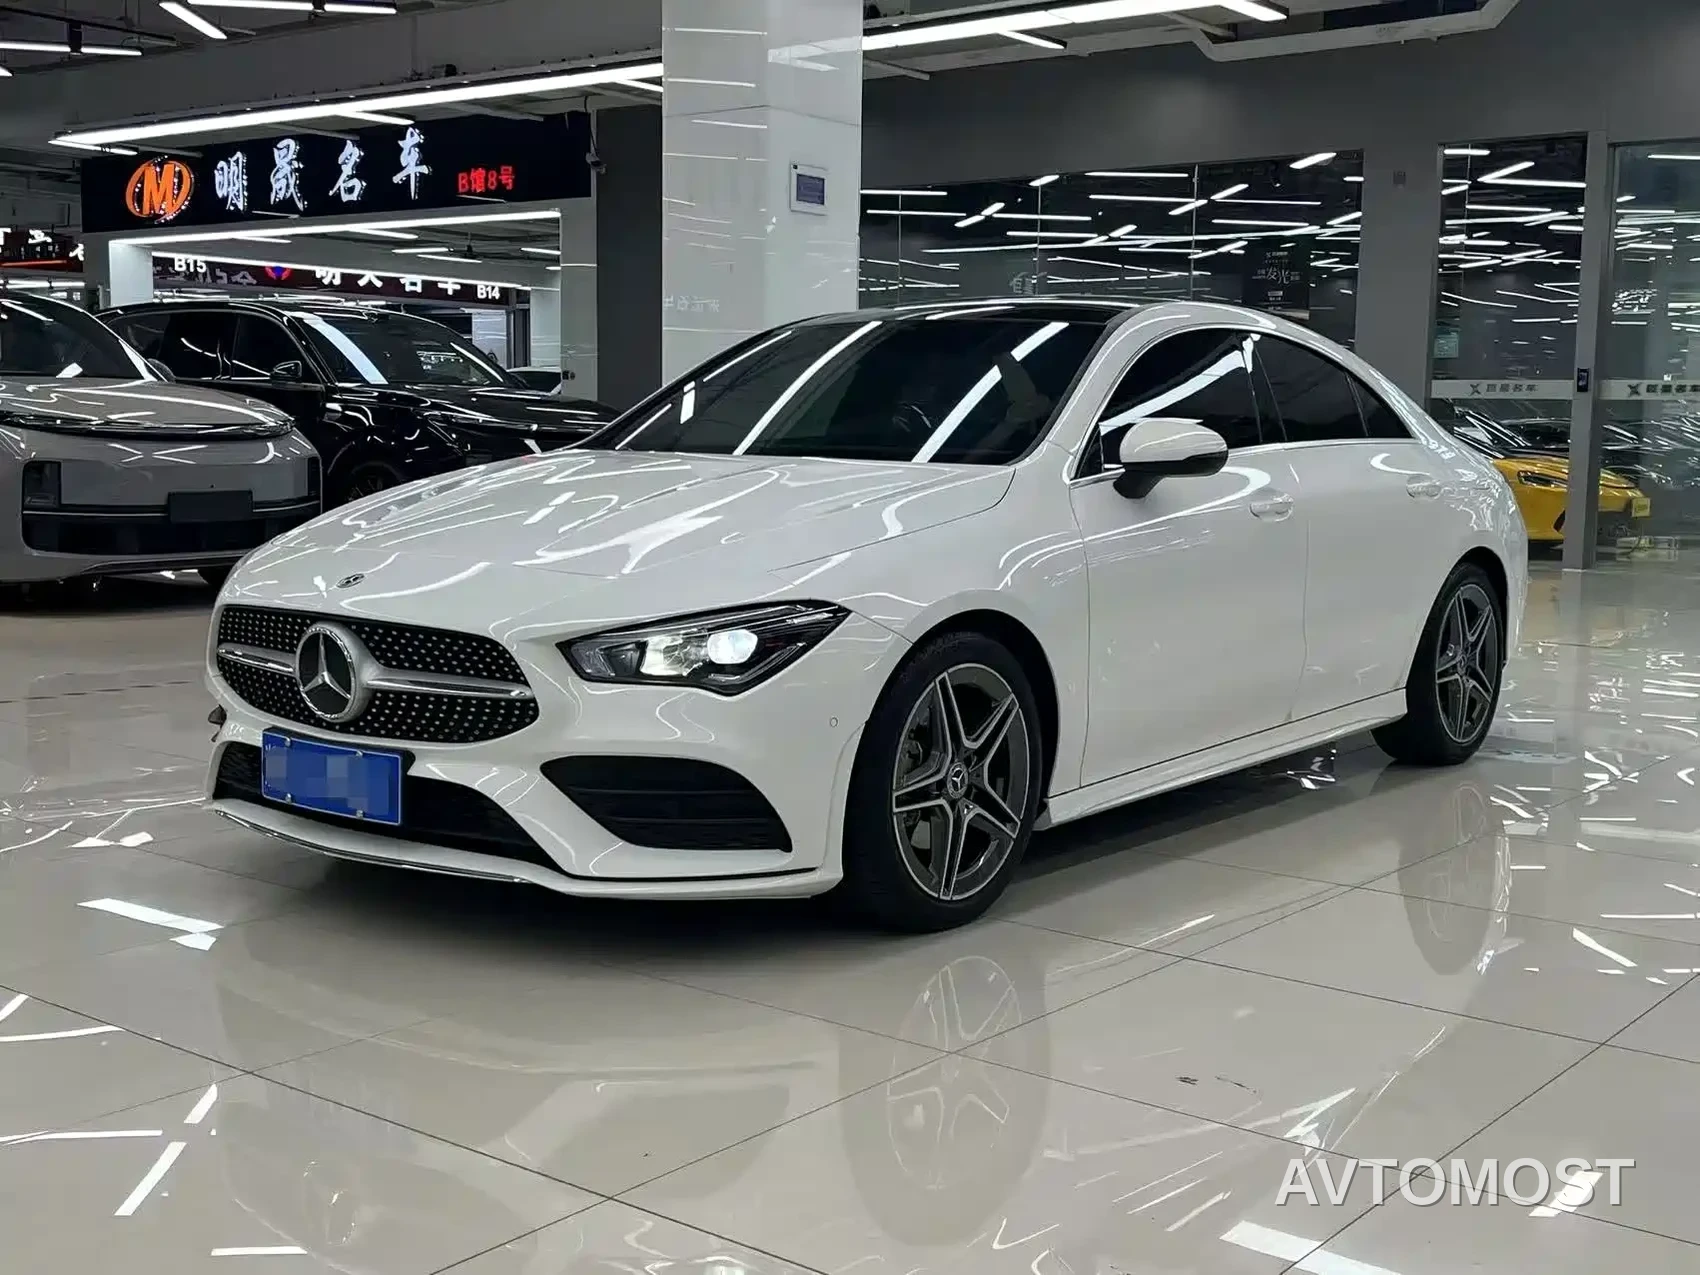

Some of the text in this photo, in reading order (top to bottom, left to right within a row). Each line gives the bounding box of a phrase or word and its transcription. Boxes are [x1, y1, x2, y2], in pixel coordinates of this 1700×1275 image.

[213, 126, 433, 213] 明晟名车
[457, 165, 516, 193] B馆8号
[173, 257, 207, 273] B15
[476, 284, 501, 300] B14
